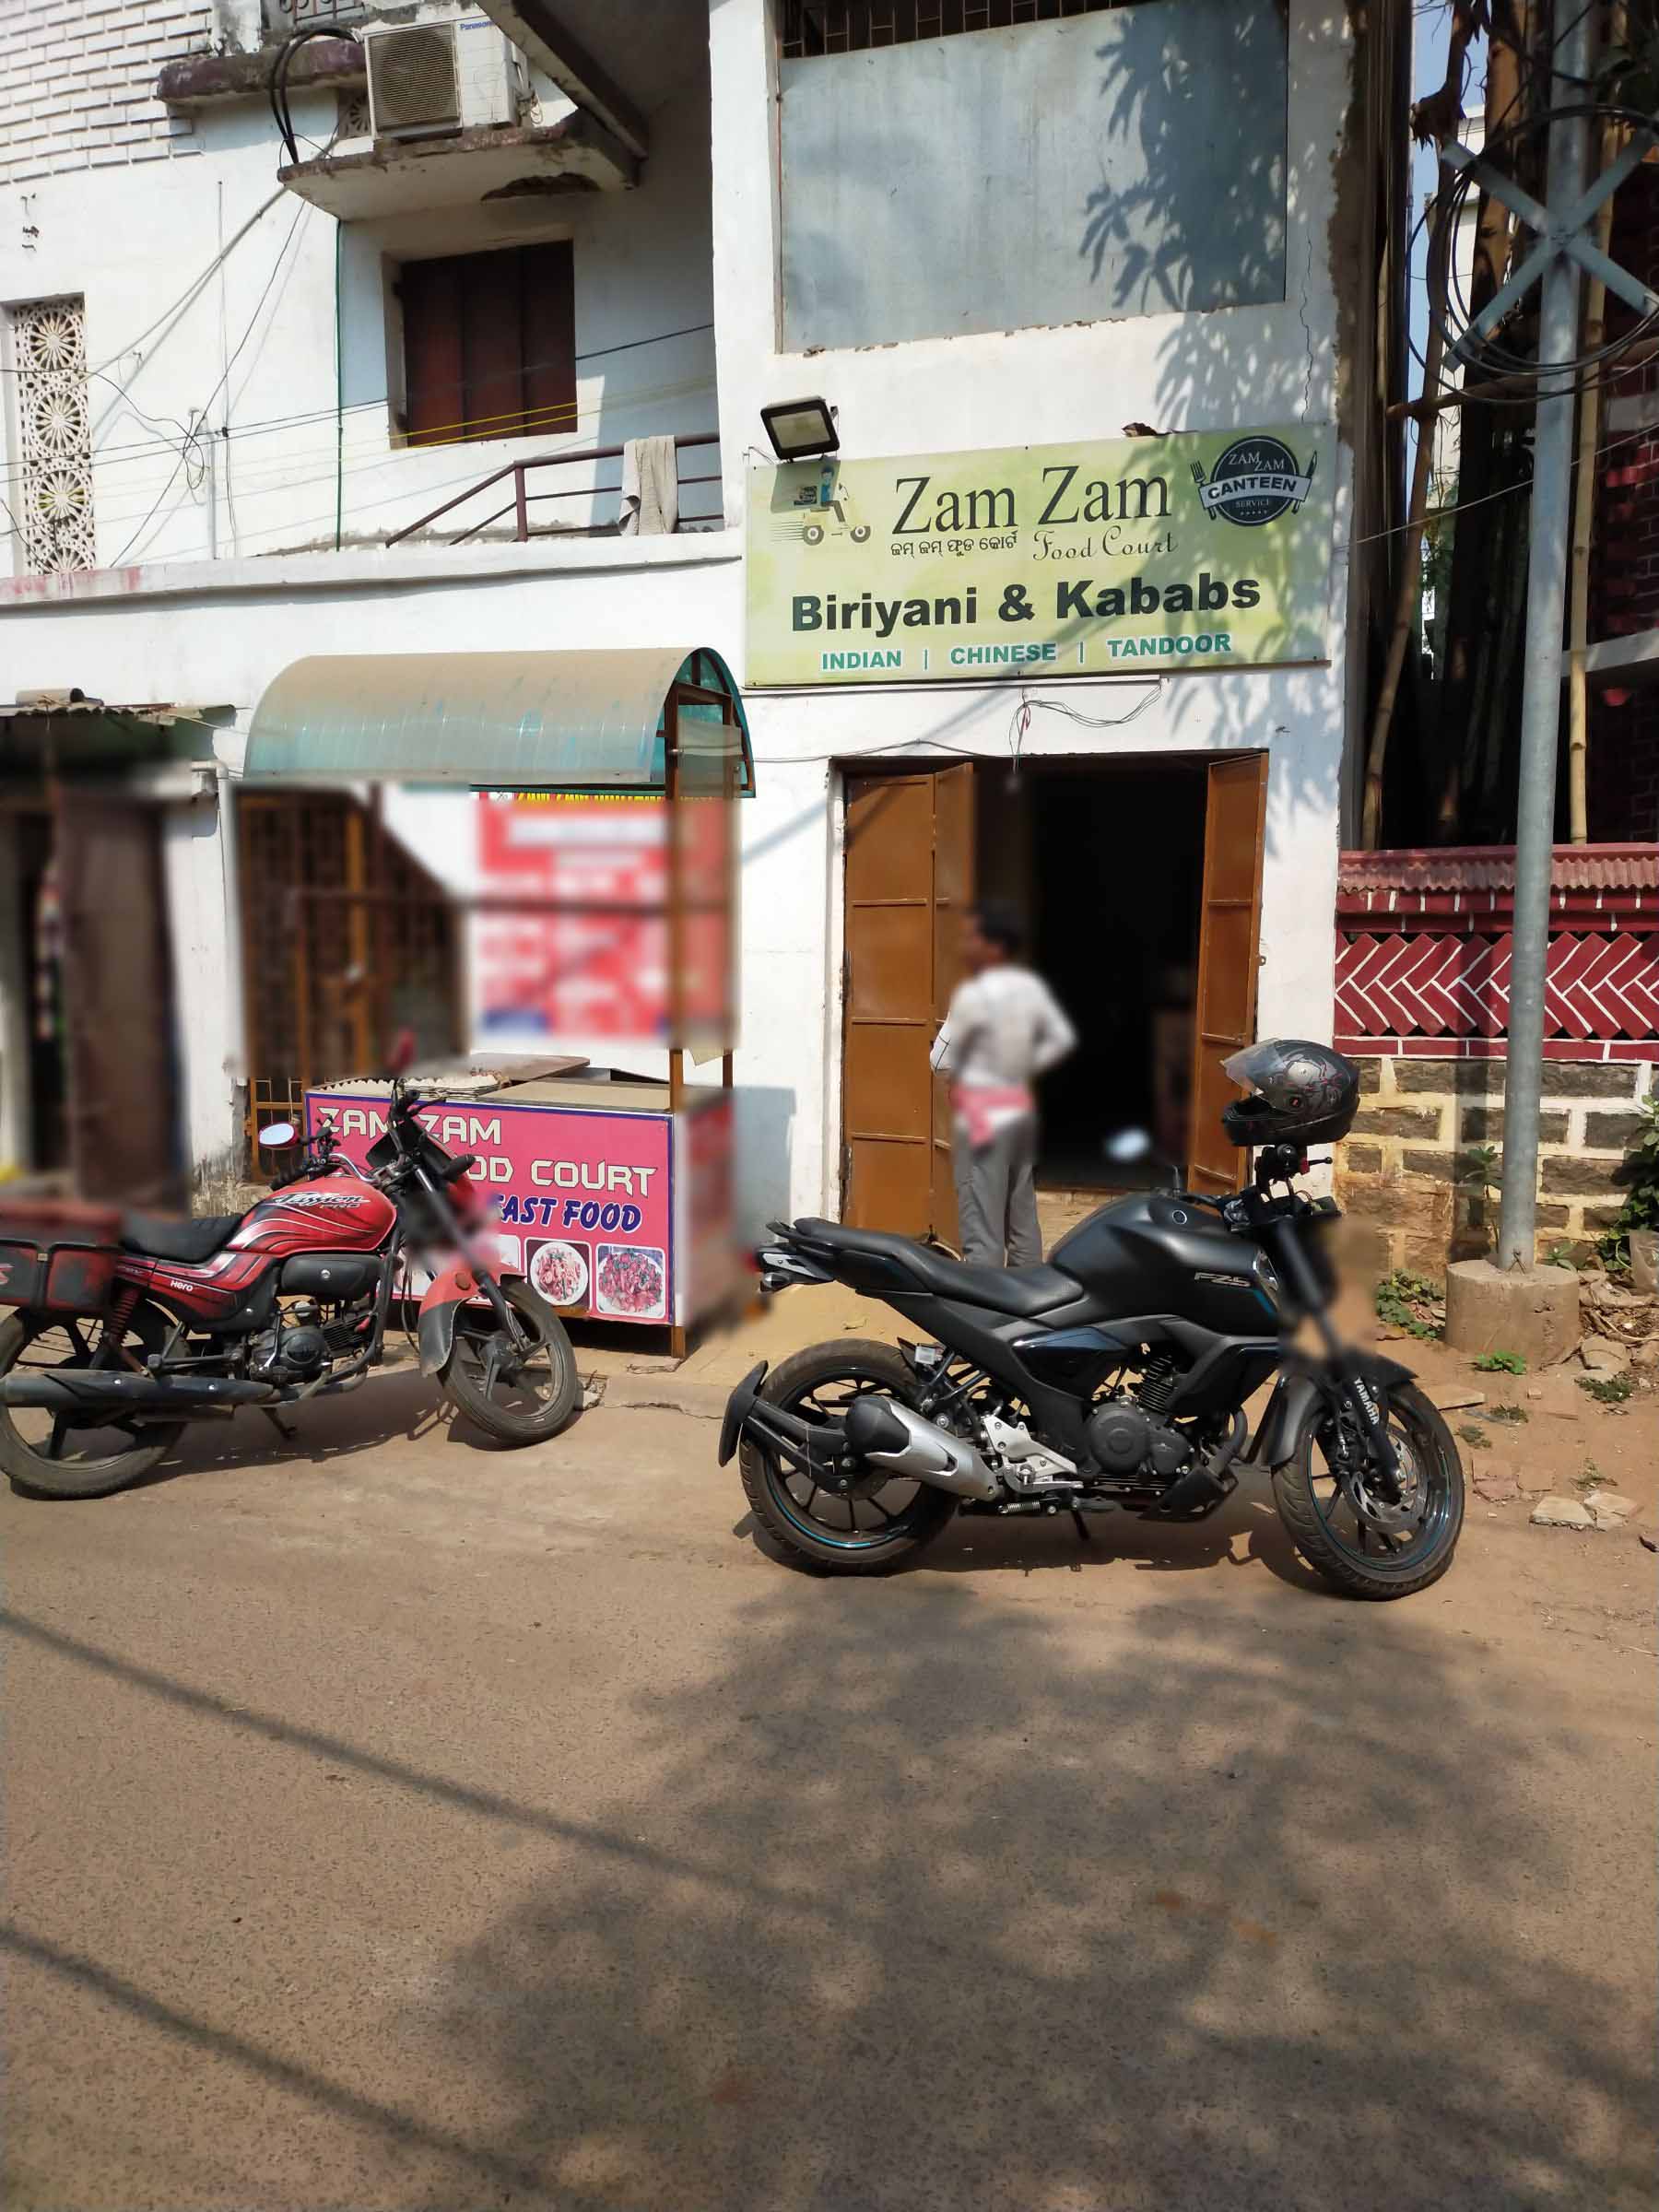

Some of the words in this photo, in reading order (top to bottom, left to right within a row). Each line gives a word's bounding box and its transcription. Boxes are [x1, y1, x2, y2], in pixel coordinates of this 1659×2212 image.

[1228, 451, 1261, 465] ZAM
[1254, 459, 1285, 472] ZAM
[891, 476, 1018, 535] Zam
[1038, 465, 1171, 525] Zam
[1207, 477, 1297, 500] CANTEEN
[1032, 530, 1092, 561] Food
[1102, 524, 1179, 558] Court
[792, 586, 977, 638] Biriyani
[998, 583, 1035, 622] &
[1056, 572, 1261, 619] Kababs
[822, 650, 902, 670] INDIAN
[950, 642, 1056, 665] CHINESE
[1107, 633, 1231, 657] TANDOOR
[317, 1107, 391, 1139] ZAM
[418, 1114, 502, 1147] ZAM
[466, 1156, 515, 1182] OD
[531, 1159, 658, 1197] COURT
[563, 1200, 642, 1233] FOOD
[171, 1279, 194, 1292] Hero
[1354, 1376, 1380, 1425] YAMAHA
